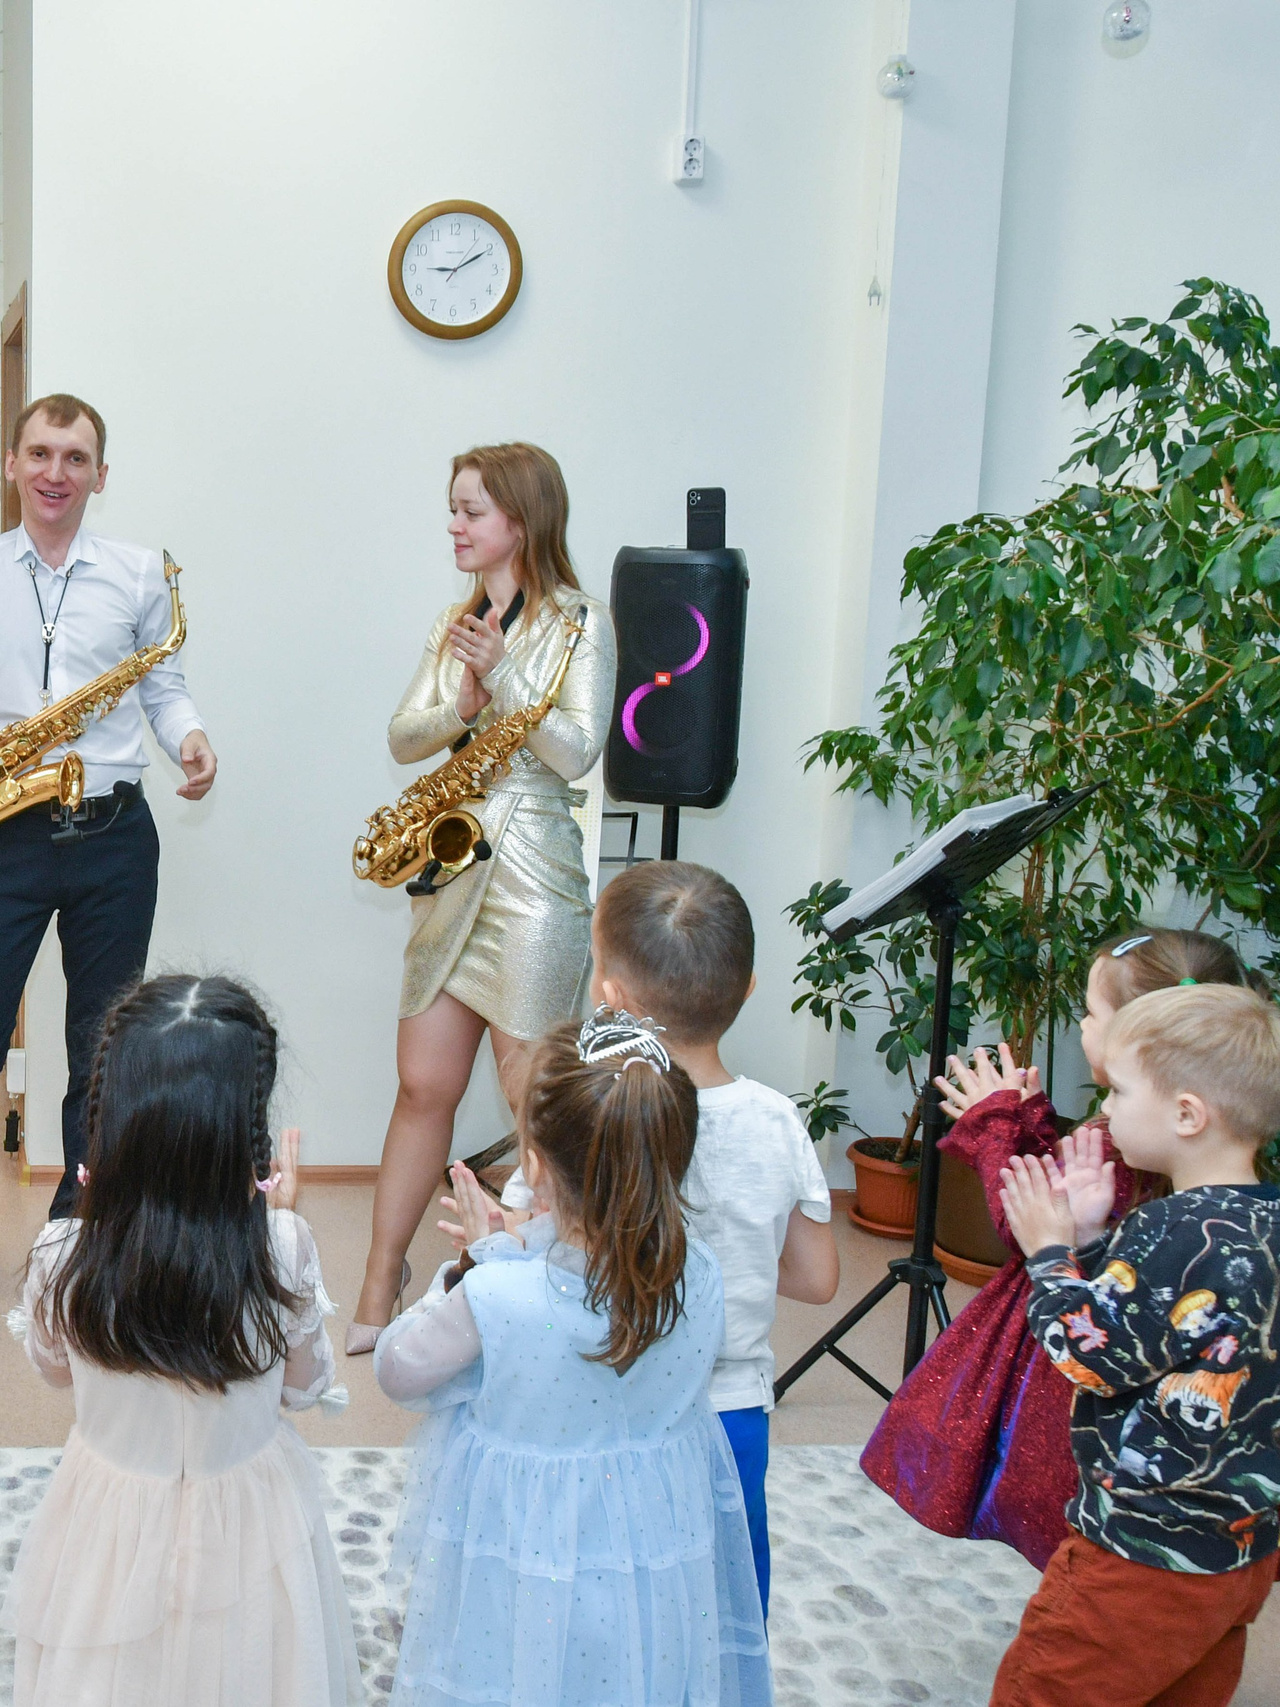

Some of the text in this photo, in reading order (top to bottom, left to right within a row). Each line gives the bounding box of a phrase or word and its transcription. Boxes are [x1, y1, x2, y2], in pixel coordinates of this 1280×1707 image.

[450, 222, 460, 236] 12
[472, 229, 476, 241] 1
[430, 229, 440, 242] 11
[416, 244, 427, 256] 10
[486, 243, 493, 256] 2
[409, 264, 417, 276] 9
[492, 264, 498, 276] 3
[415, 284, 423, 296] 8
[486, 284, 492, 295] 4
[430, 299, 437, 311] 7
[470, 299, 476, 310] 5
[449, 305, 457, 317] 6
